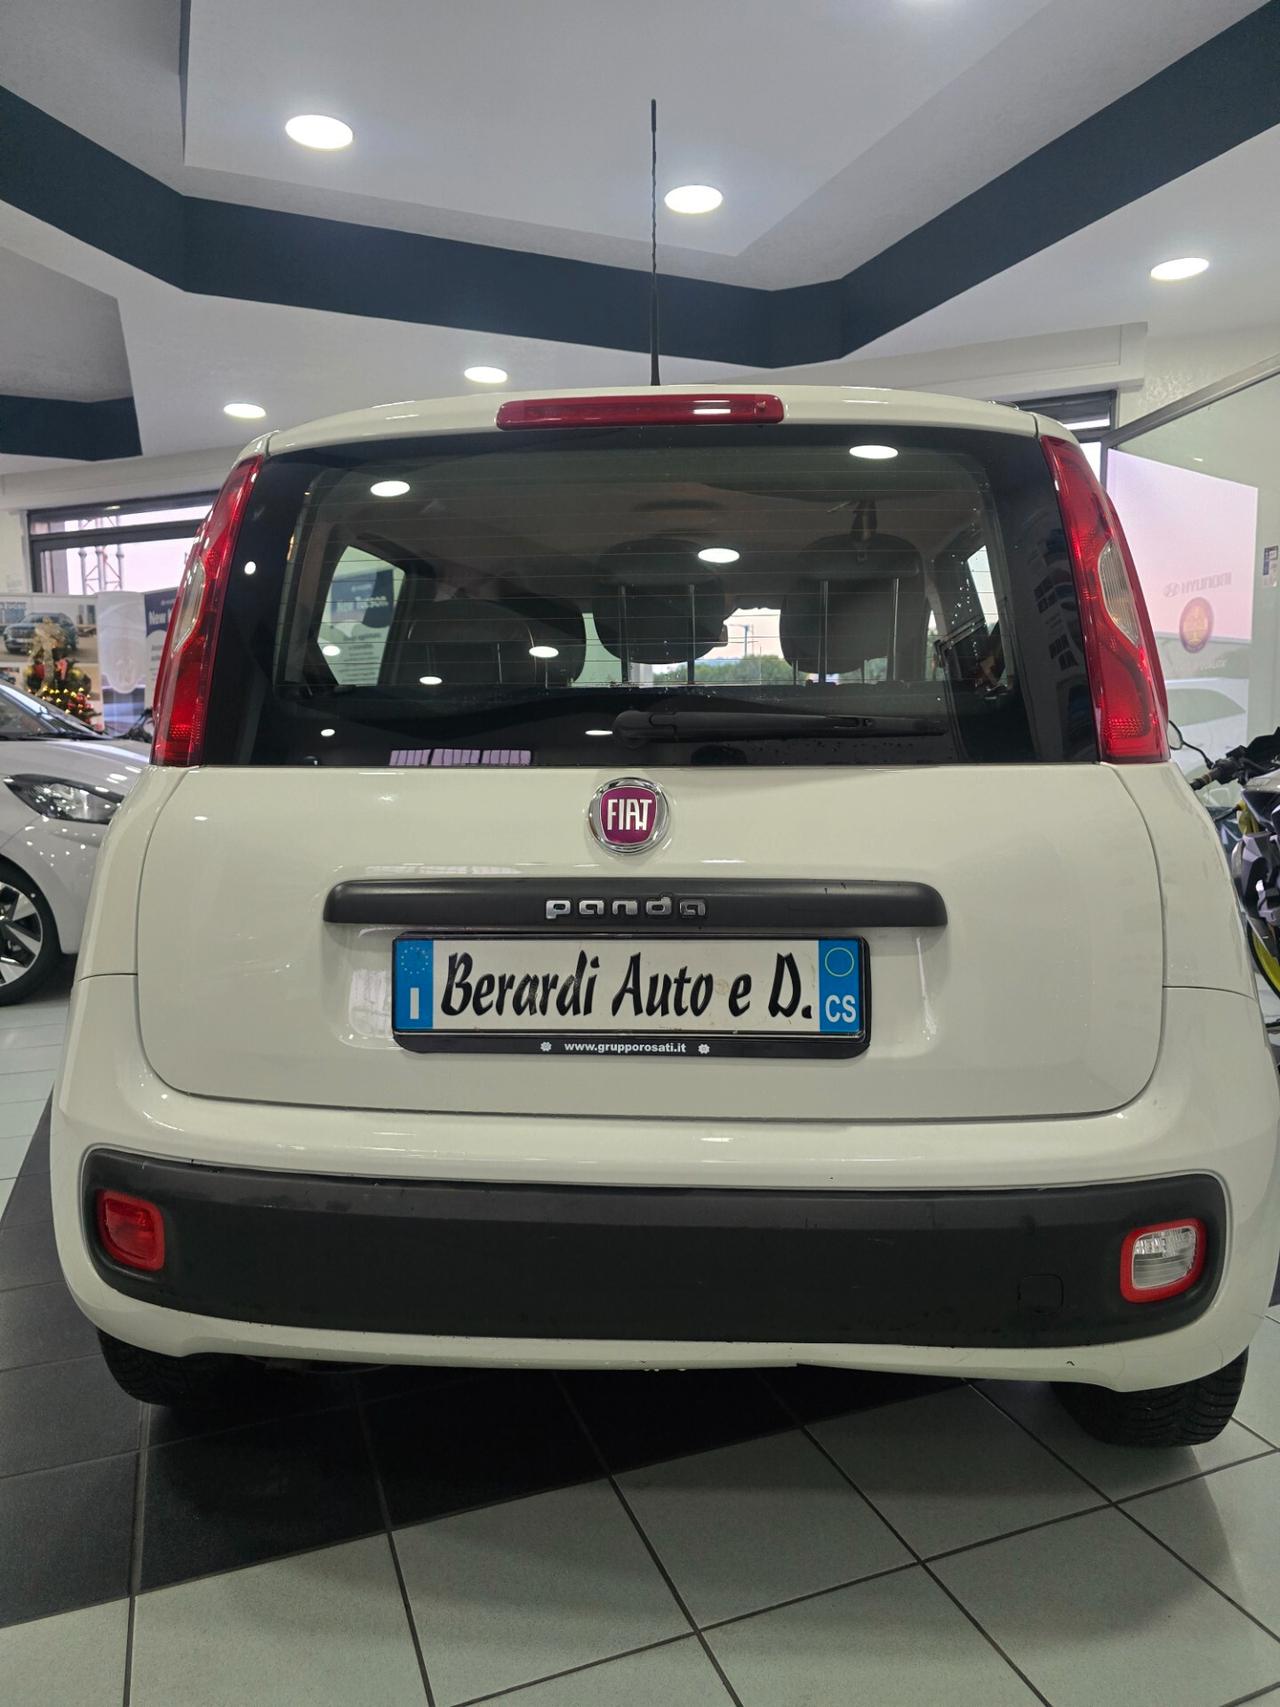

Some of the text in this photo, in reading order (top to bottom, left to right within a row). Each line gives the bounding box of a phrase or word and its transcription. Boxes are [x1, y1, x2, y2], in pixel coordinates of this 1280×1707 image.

[607, 798, 652, 831] FIAT
[545, 896, 706, 920] panda
[440, 949, 813, 1020] Berardi Auto e D.
[409, 987, 420, 1020] I
[824, 993, 857, 1024] CS
[564, 1040, 687, 1055] www.grupporosati.it
